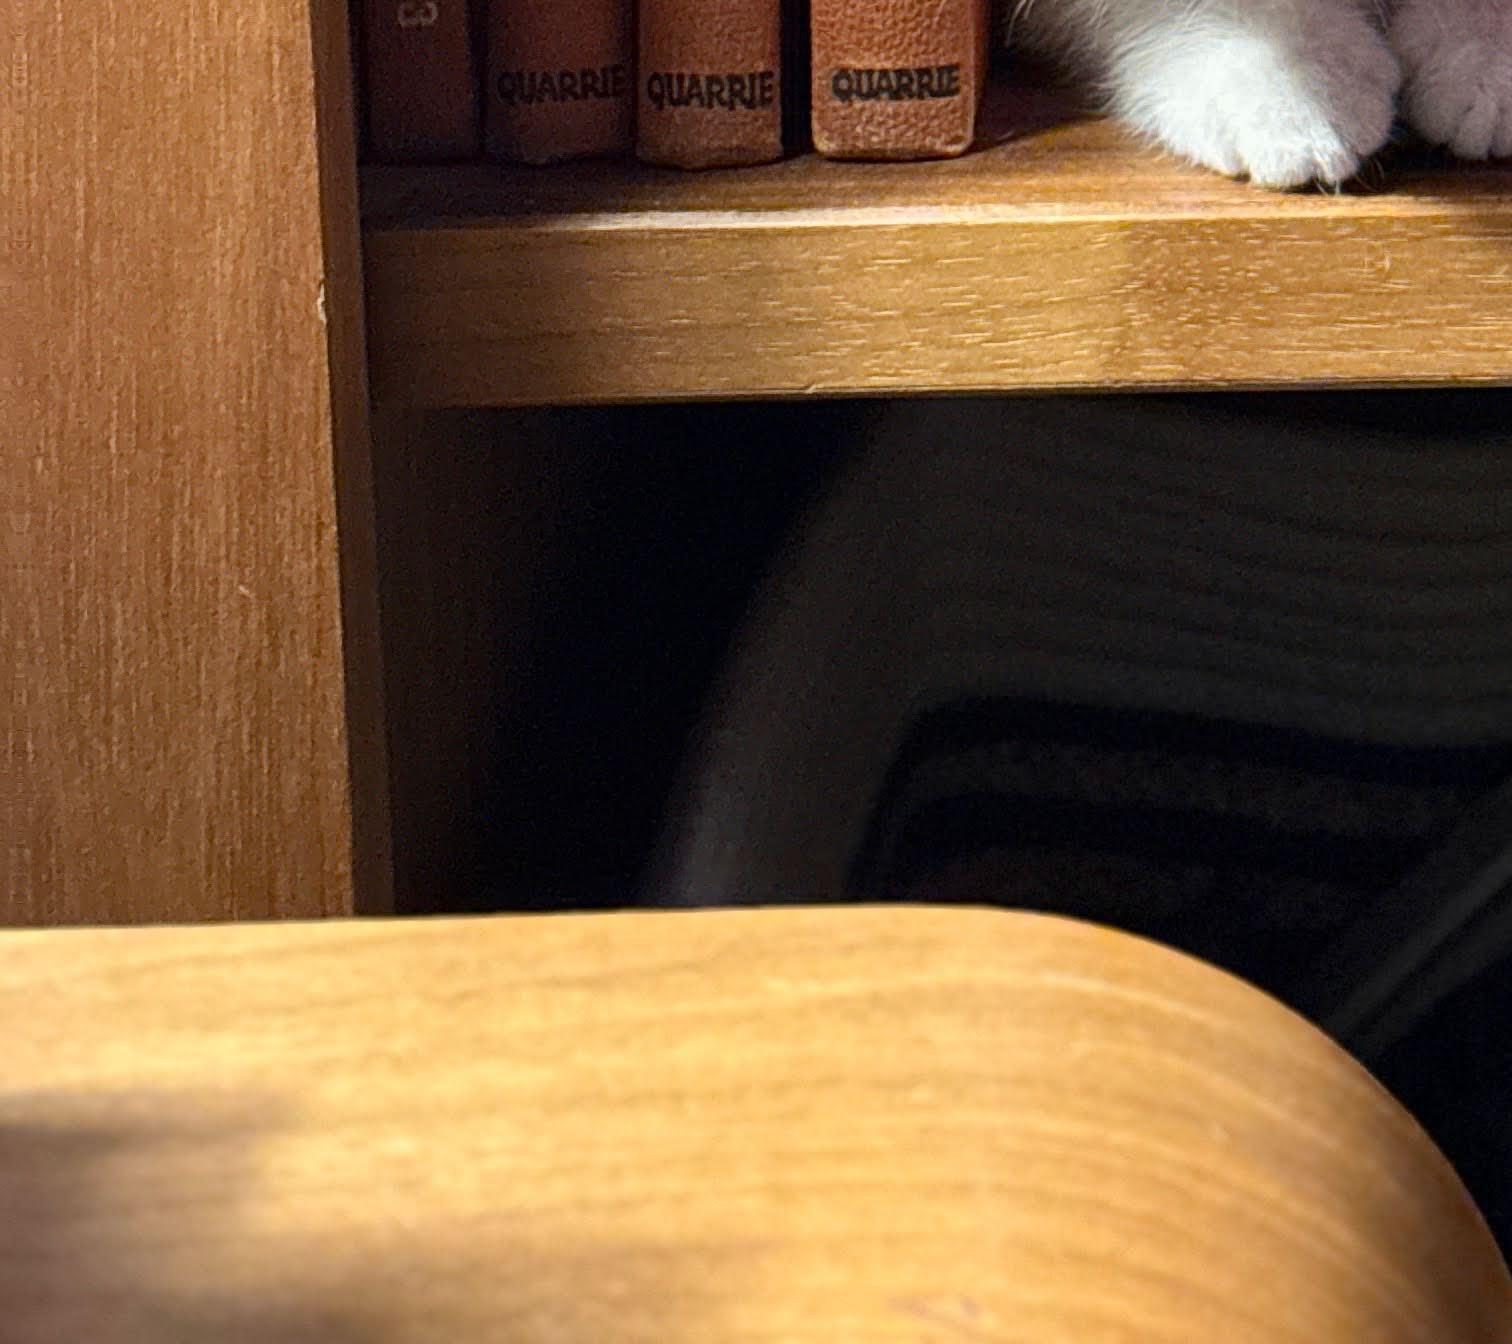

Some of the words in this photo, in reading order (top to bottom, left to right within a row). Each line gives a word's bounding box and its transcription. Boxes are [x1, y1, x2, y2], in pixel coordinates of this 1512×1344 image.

[496, 63, 626, 106] QUARRIE
[645, 70, 775, 111] QUARRIE
[830, 63, 960, 102] QUARRIE
